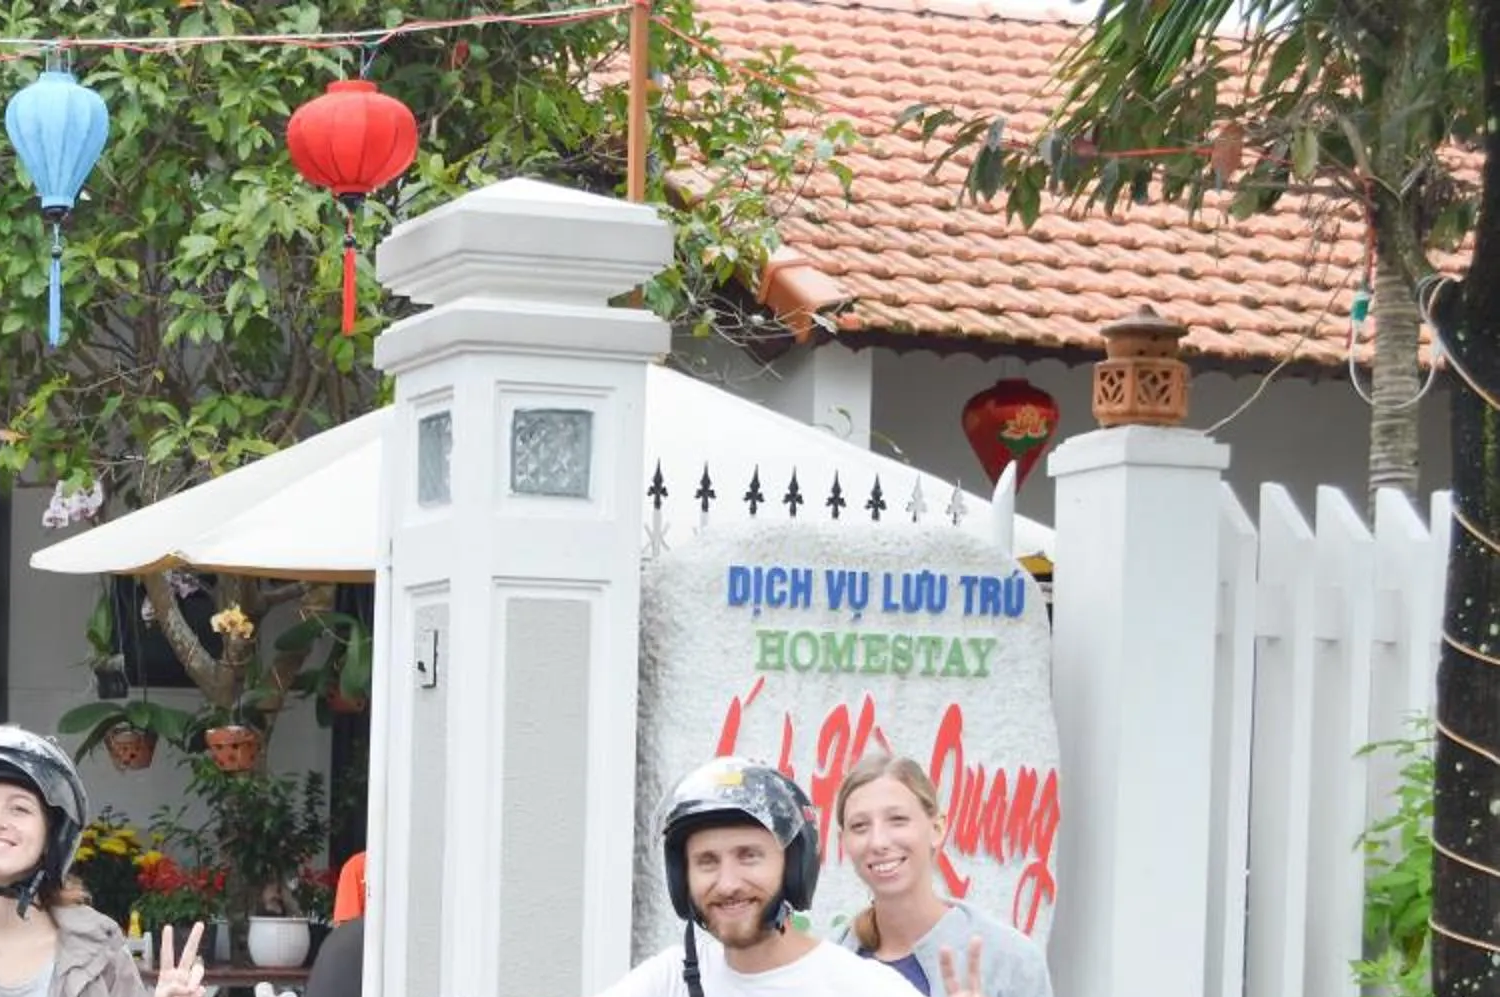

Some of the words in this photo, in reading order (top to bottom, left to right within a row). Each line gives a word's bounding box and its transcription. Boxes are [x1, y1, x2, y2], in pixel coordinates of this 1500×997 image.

[727, 565, 813, 617] DỊCH
[824, 569, 869, 620] VỤ
[959, 569, 1026, 619] TRÚ
[754, 629, 998, 678] HOMESTAY
